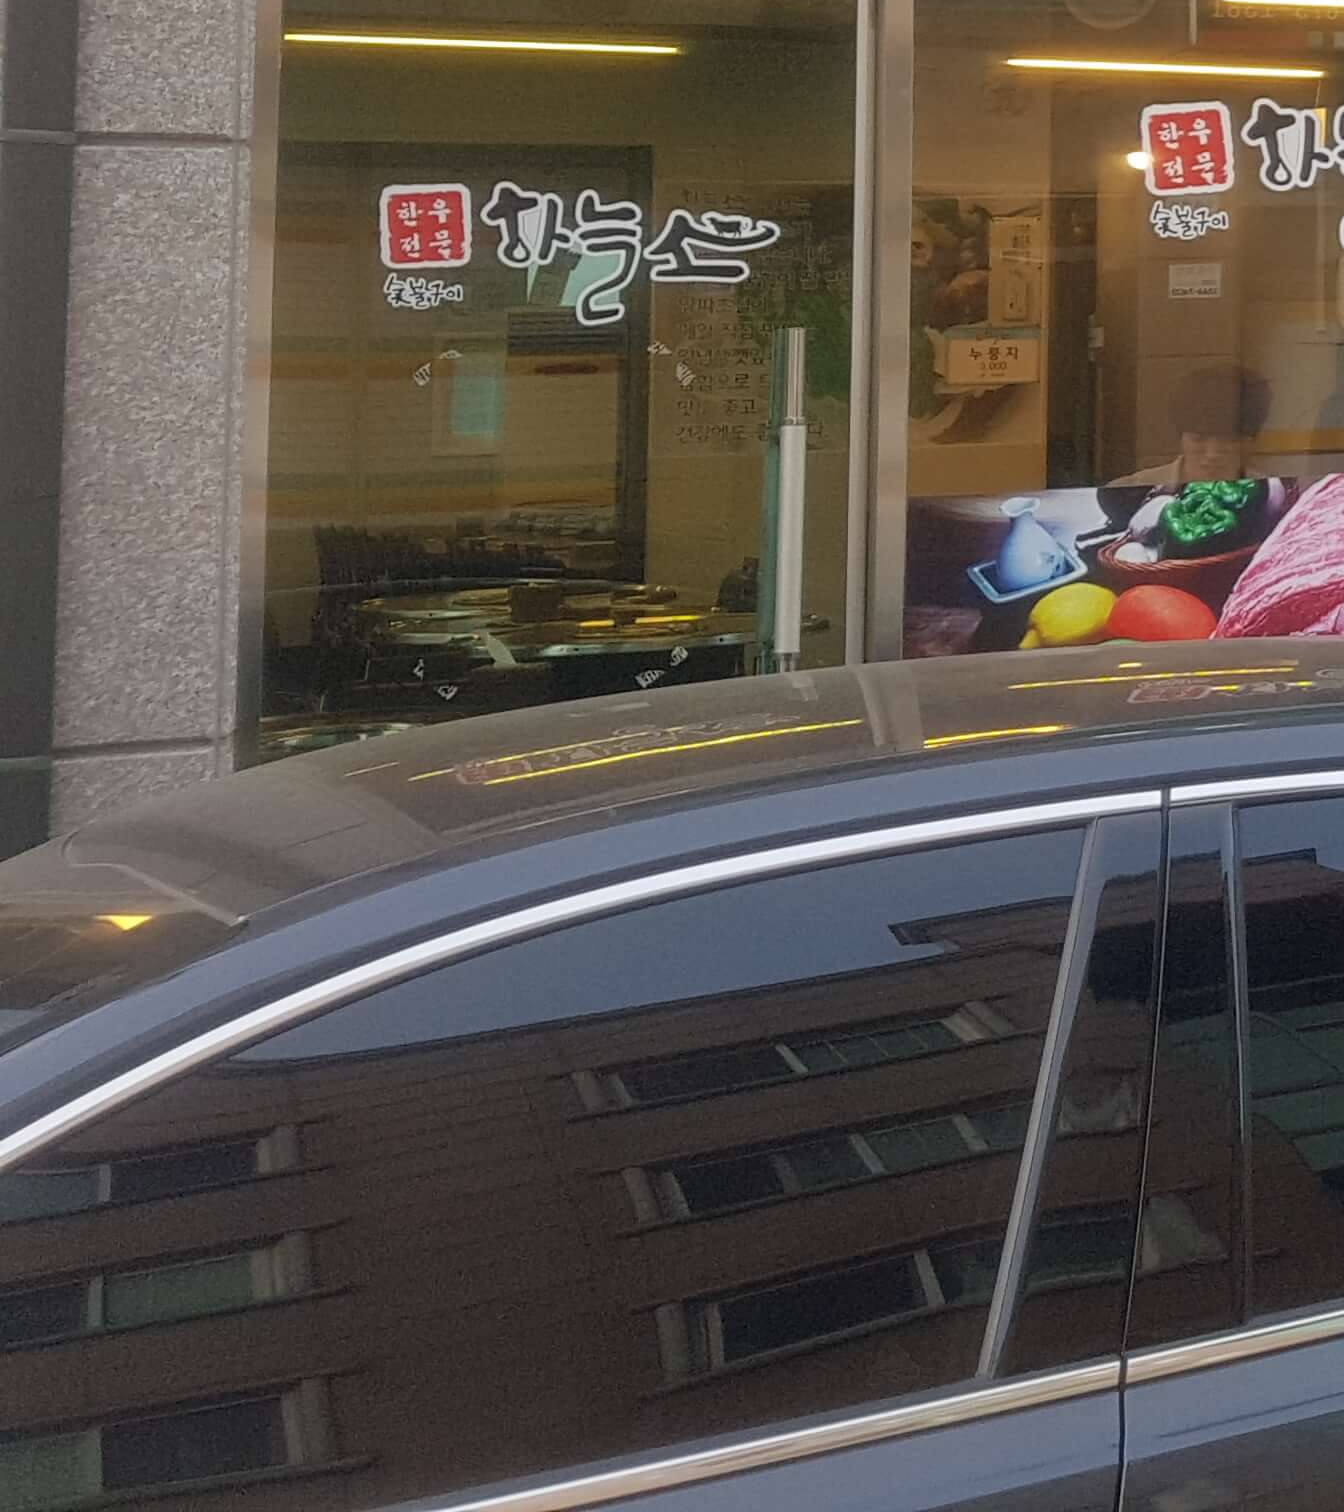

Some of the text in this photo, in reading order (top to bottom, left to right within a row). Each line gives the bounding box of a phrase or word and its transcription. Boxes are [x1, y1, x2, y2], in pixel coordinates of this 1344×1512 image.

[1157, 118, 1213, 150] 한우
[1162, 151, 1216, 185] 전문
[396, 198, 451, 230] 한우
[1151, 200, 1230, 240] 숯불구이
[397, 231, 453, 260] 전문
[481, 181, 780, 325] 하늘소
[383, 275, 464, 309] 숯불구이
